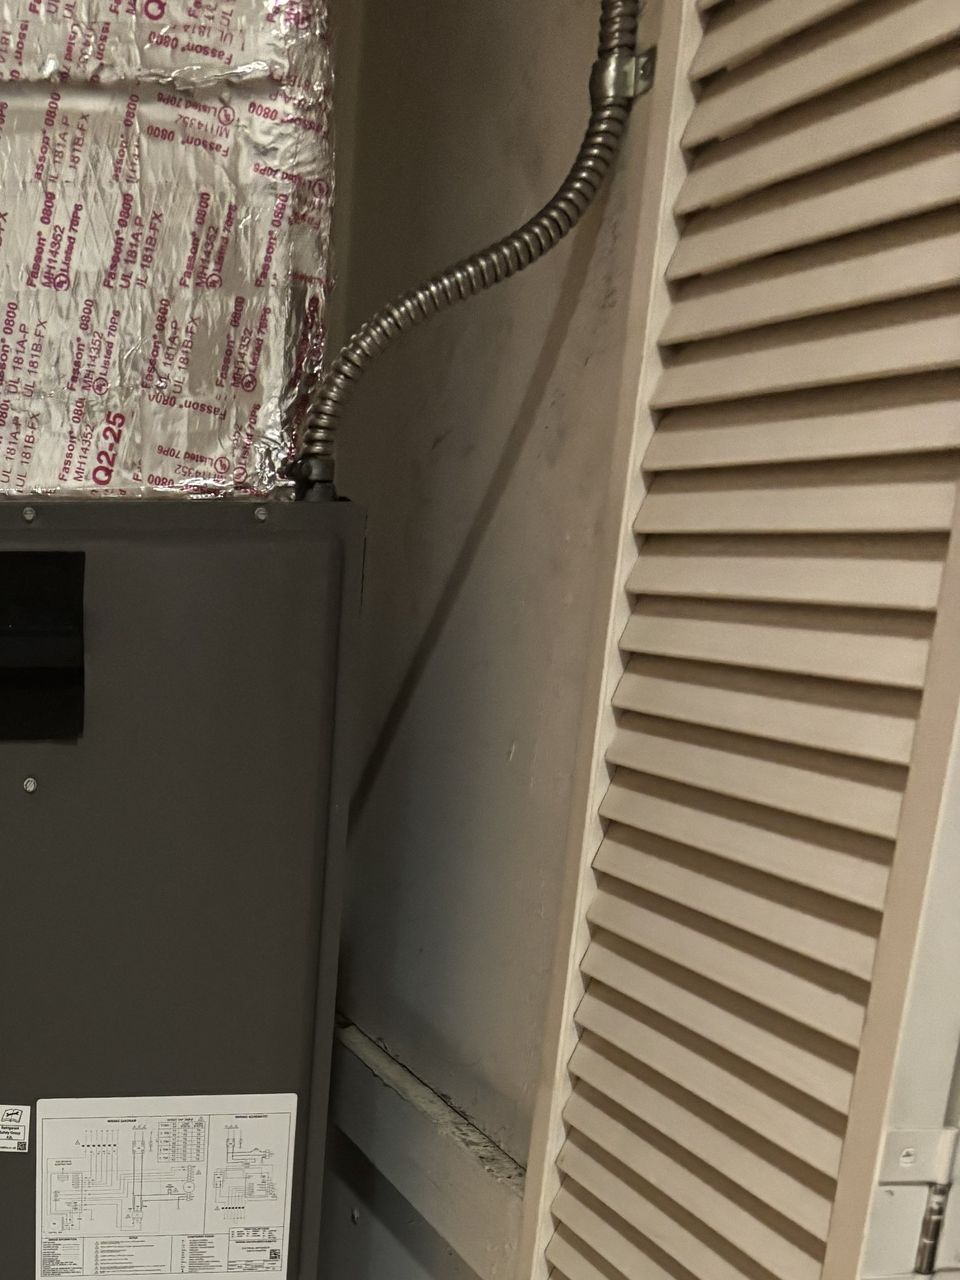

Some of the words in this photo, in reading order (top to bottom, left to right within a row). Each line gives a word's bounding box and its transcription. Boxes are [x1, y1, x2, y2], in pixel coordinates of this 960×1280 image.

[148, 125, 175, 141] 0800
[69, 204, 83, 233] 70P6
[3, 302, 18, 335] 0800
[13, 323, 28, 372] 181A-P
[28, 319, 47, 376] 181B-FX
[8, 378, 21, 394] UL
[23, 381, 35, 398] UL
[21, 413, 40, 466] 181B-FX
[92, 411, 126, 486] Q2-25
